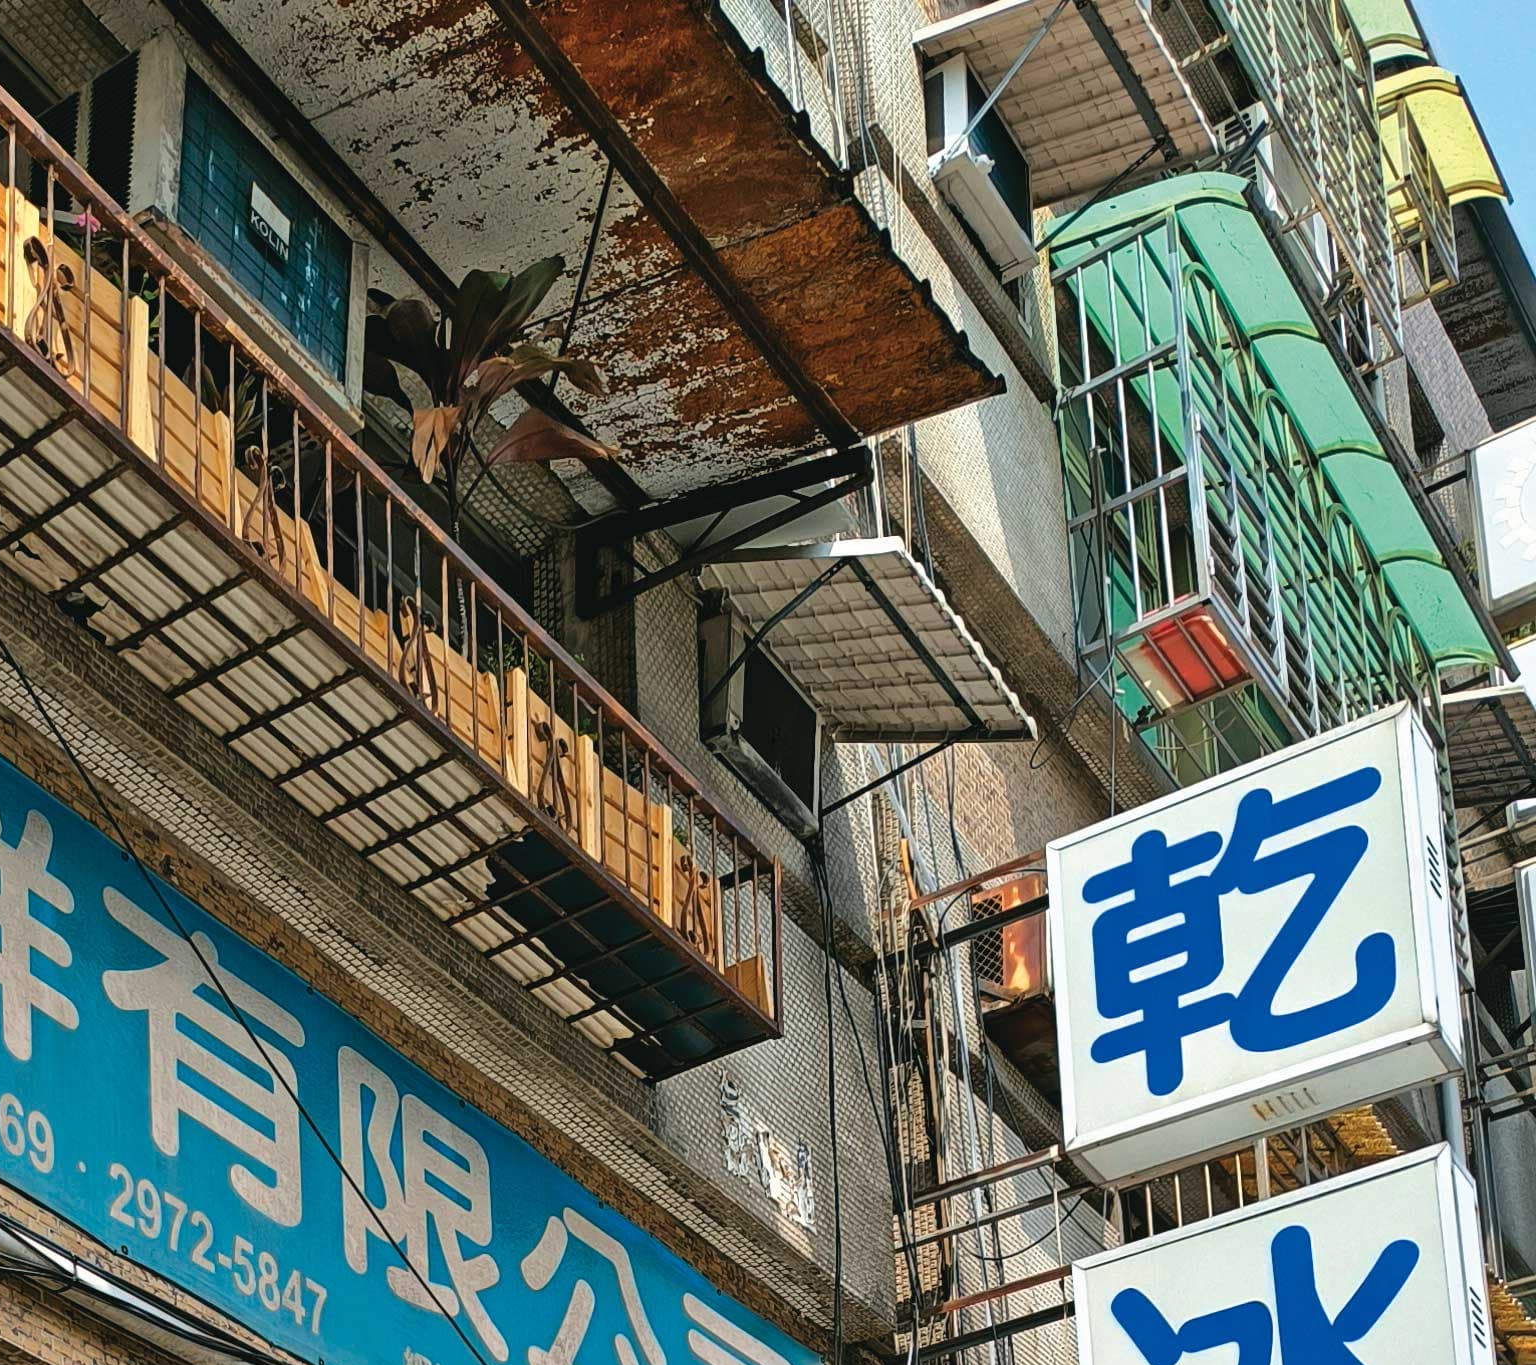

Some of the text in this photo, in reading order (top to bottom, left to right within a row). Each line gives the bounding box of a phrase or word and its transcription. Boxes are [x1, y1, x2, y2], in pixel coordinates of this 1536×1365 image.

[251, 210, 289, 262] KOLIN
[1081, 765, 1397, 1097] 乾
[108, 1163, 329, 1335] 2972-5847
